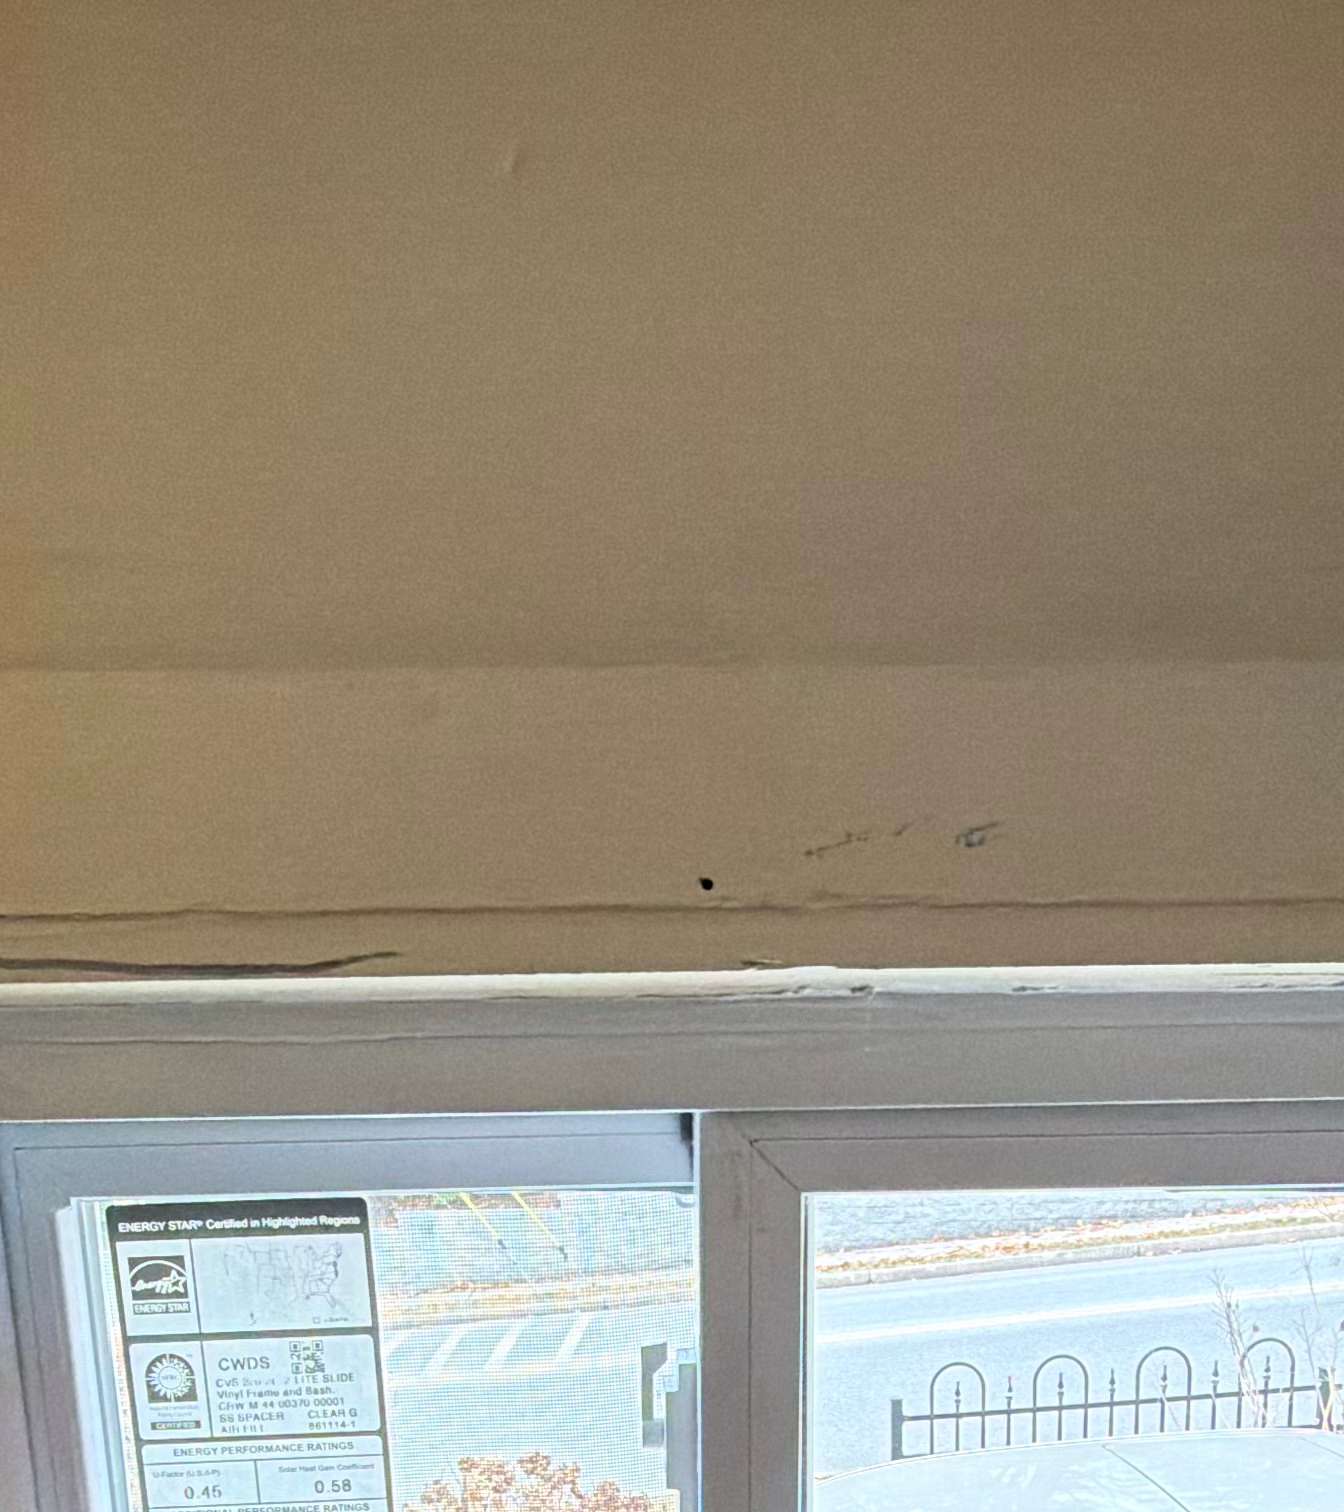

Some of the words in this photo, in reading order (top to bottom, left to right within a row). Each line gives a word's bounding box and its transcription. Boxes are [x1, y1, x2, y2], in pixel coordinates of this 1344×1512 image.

[118, 1221, 166, 1233] ENERGY
[205, 1217, 248, 1230] Certified
[250, 1217, 260, 1228] in
[262, 1215, 317, 1229] Highlighted
[319, 1214, 360, 1228] Regions
[134, 1303, 166, 1314] ENERGY
[168, 1302, 190, 1313] STAR
[218, 1356, 271, 1372] CWDS
[322, 1372, 355, 1383] SLIDE
[173, 1447, 218, 1457] ENERGY
[220, 1443, 304, 1455] PERFORMANCE
[307, 1441, 354, 1451] RATINGS
[314, 1479, 352, 1494] 0.58
[323, 1502, 370, 1512] RATINGS
